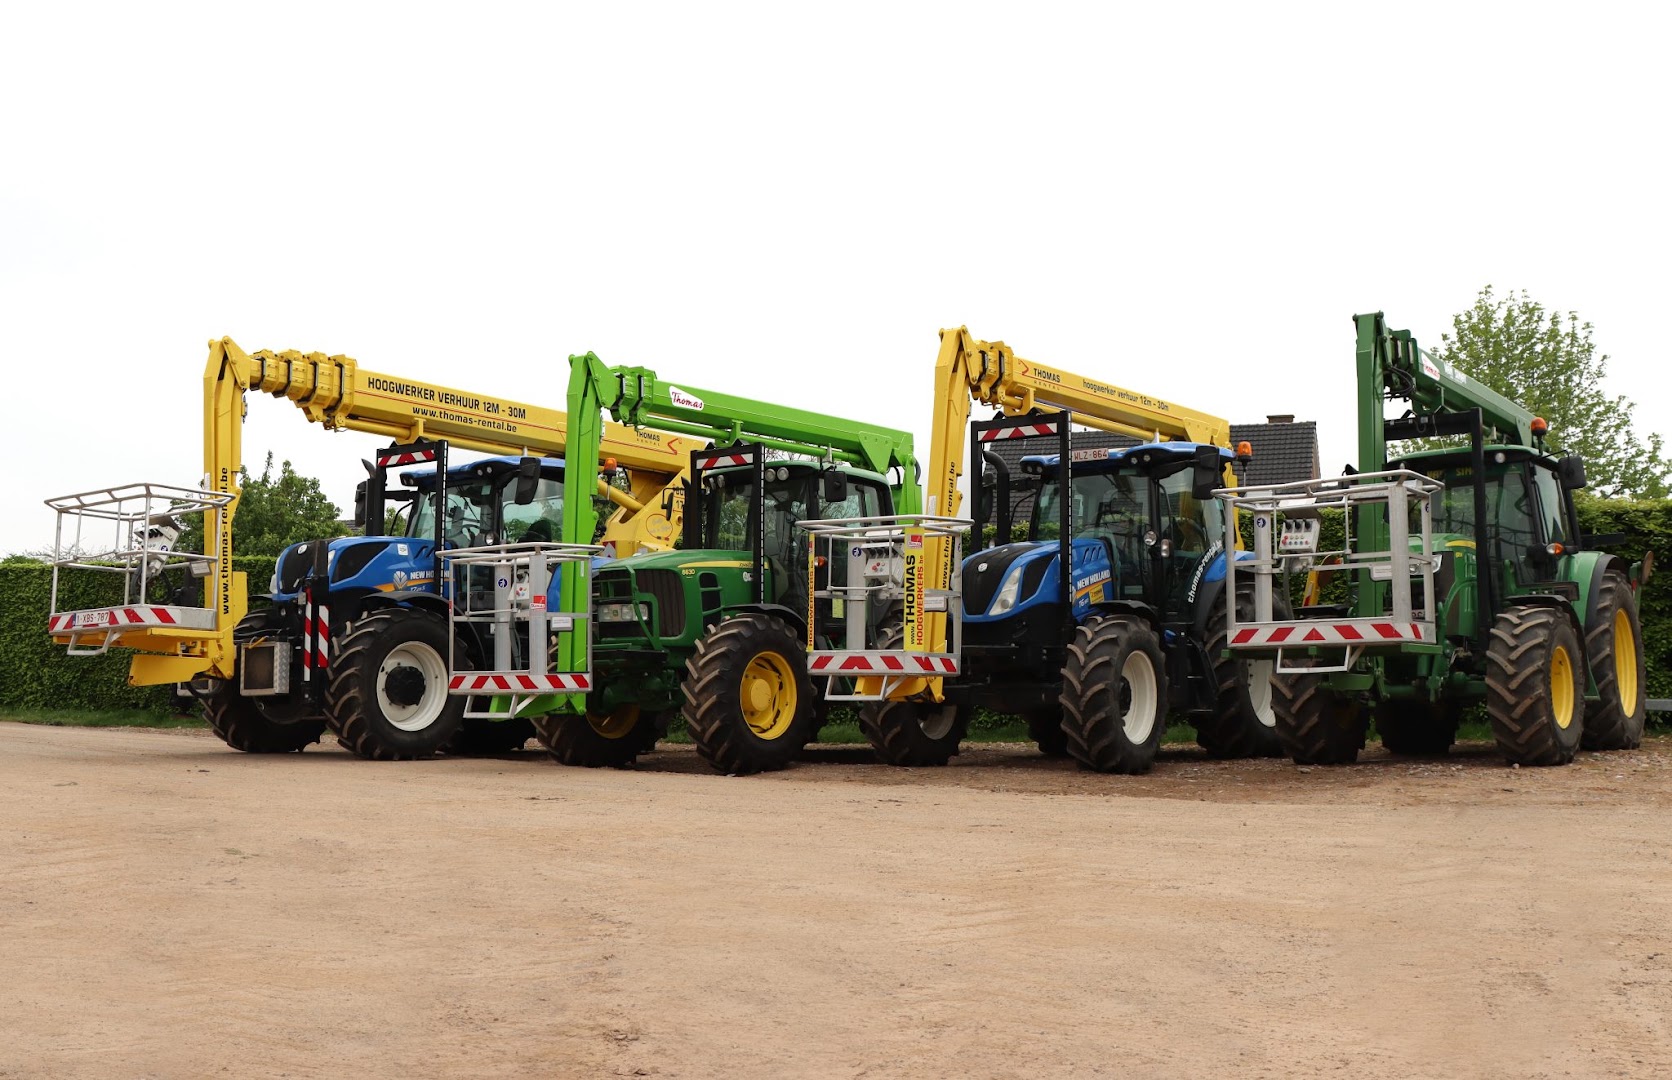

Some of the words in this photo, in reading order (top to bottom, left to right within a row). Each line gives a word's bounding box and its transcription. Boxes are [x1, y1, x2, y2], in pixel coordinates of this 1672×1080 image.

[1033, 368, 1061, 383] THOMAS
[367, 377, 434, 401] HOOGWERKER
[438, 391, 480, 410] VERHUUR
[483, 401, 500, 414] 12M
[508, 406, 526, 419] 30M
[671, 391, 703, 409] Thomas
[1082, 379, 1116, 396] hoogwerker
[1117, 389, 1139, 402] verhuur
[1140, 395, 1151, 407] 12m
[1157, 400, 1169, 411] 30m
[412, 406, 517, 433] www.thomas-rental.be
[636, 431, 660, 441] THOMAS
[410, 570, 425, 580] NEW
[1077, 576, 1090, 590] NEW
[1090, 569, 1111, 584] HOLLAND
